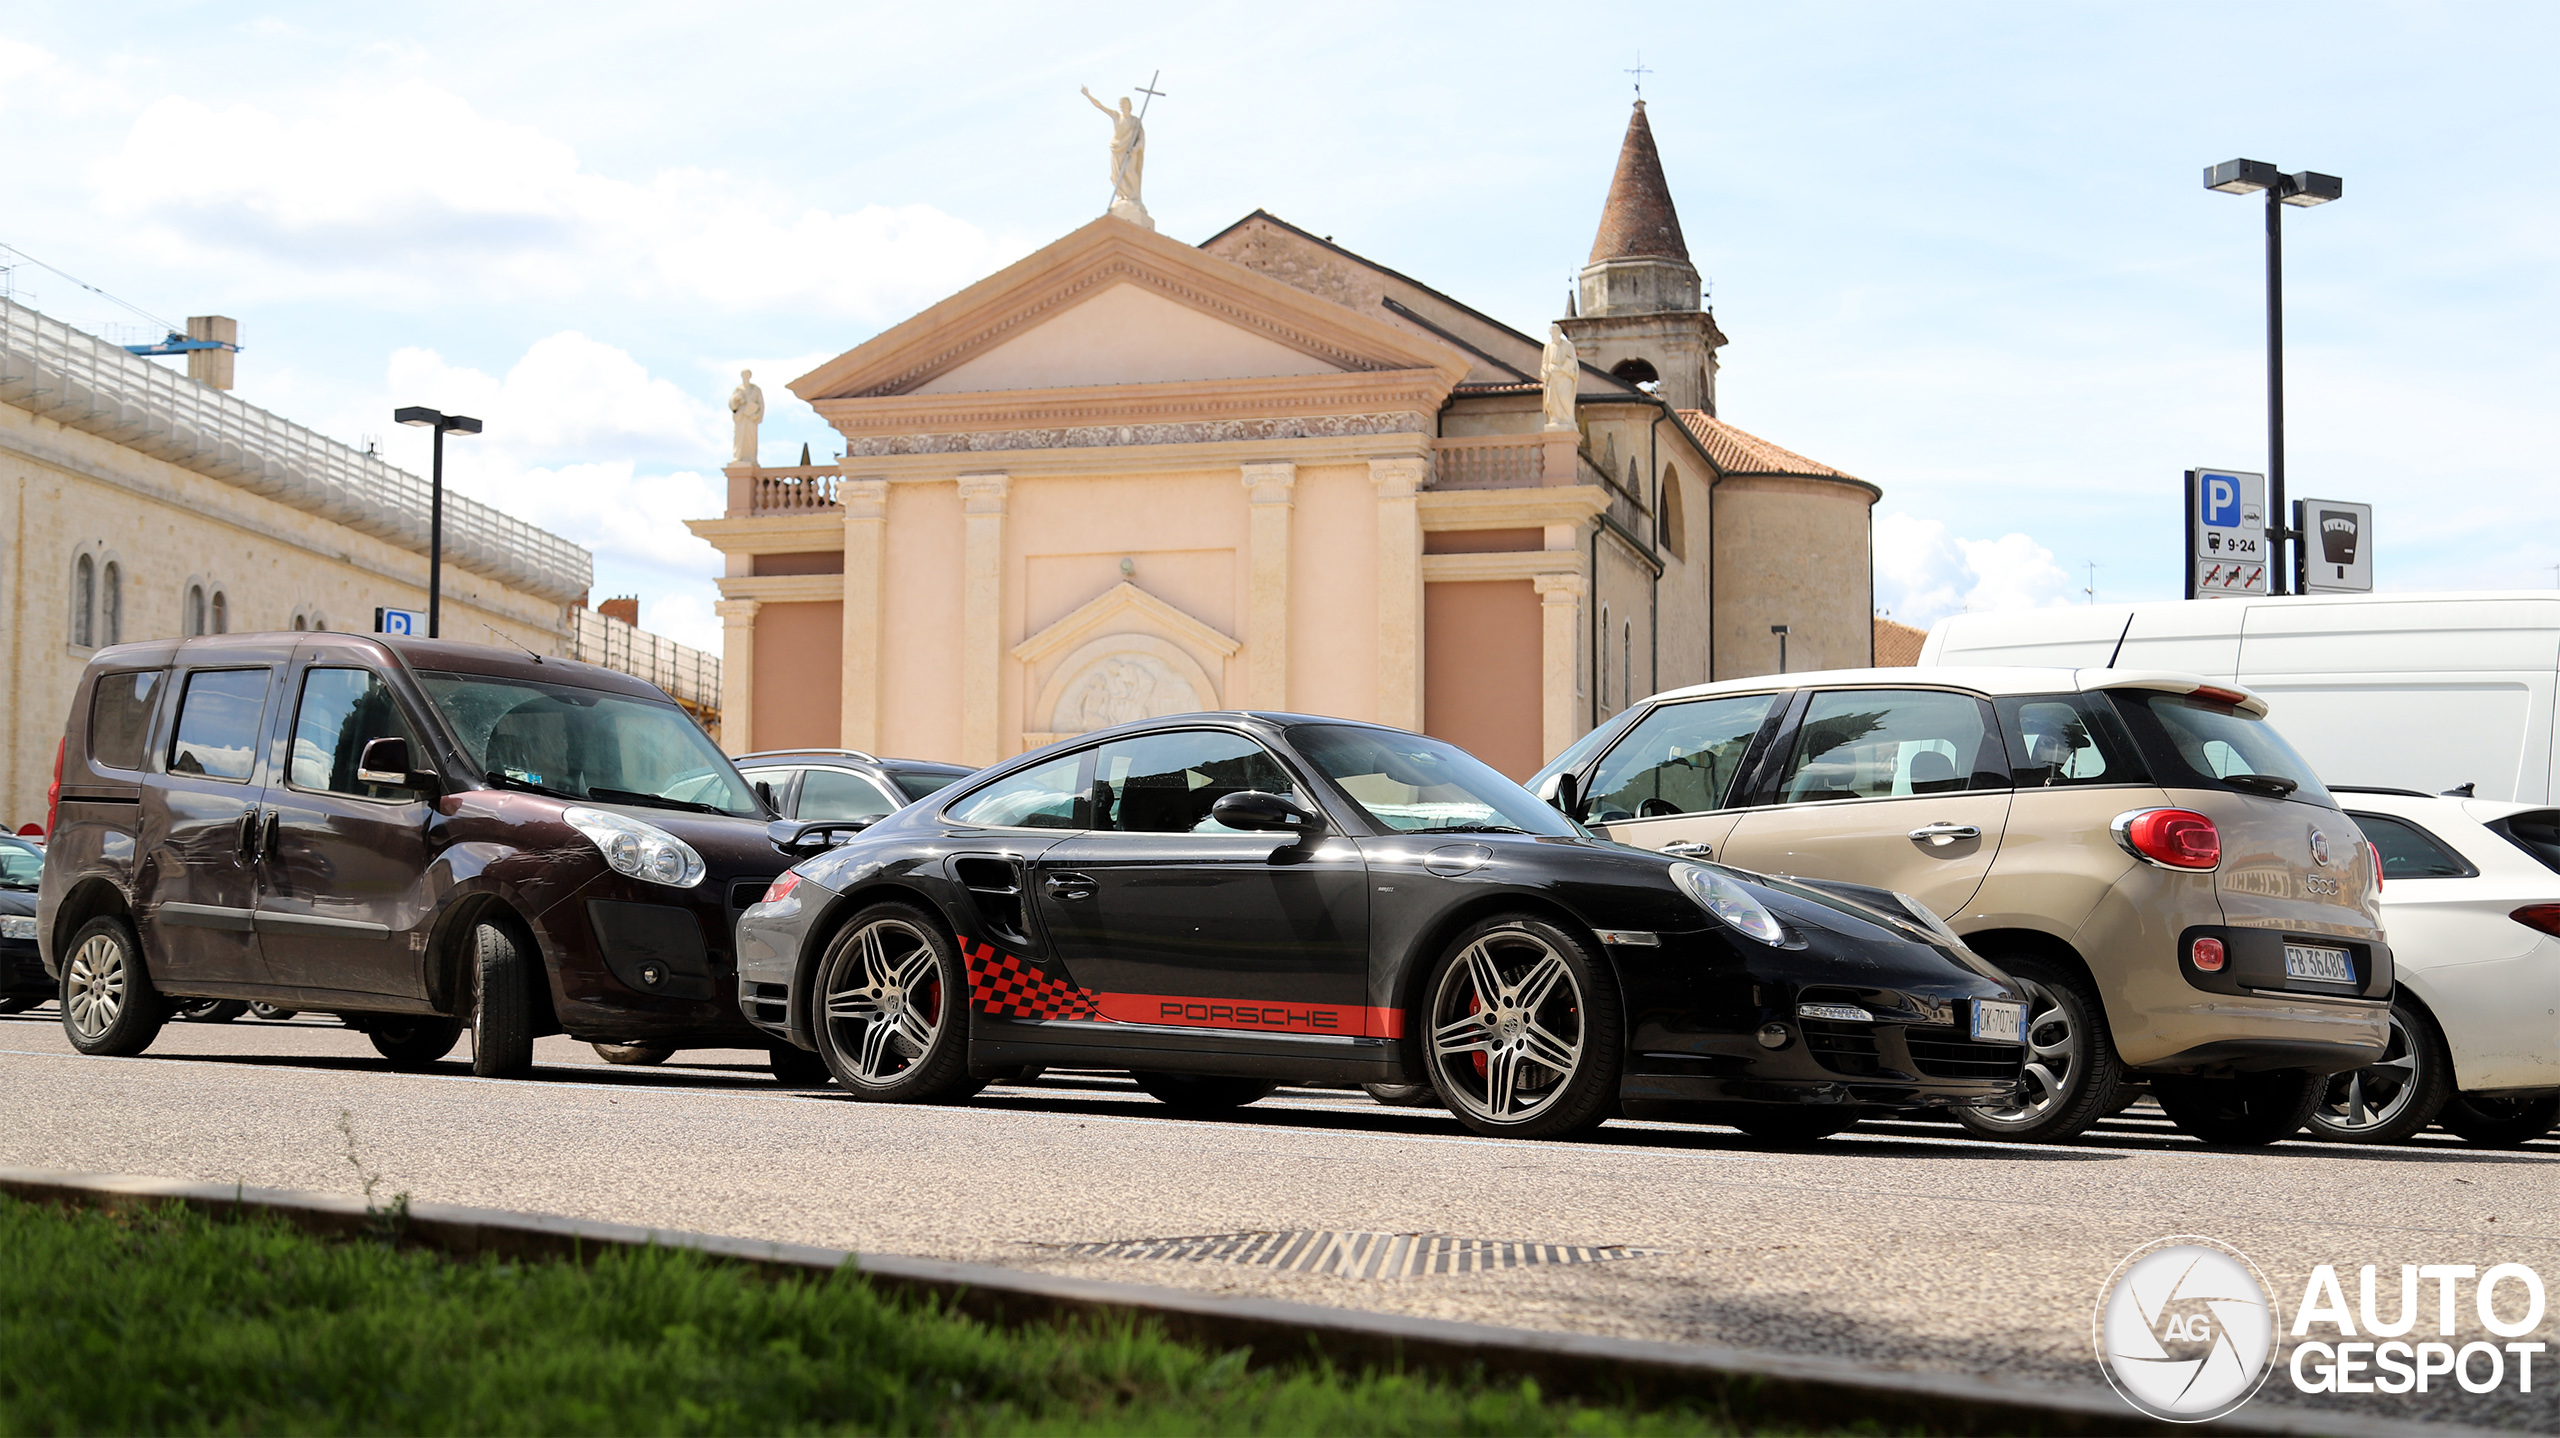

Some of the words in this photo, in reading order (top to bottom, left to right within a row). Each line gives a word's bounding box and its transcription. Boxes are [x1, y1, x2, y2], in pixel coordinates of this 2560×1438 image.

[2209, 479, 2233, 521] P
[2228, 538, 2256, 552] 9-24
[2287, 948, 2306, 975] FB
[2306, 950, 2346, 978] 364BG
[1160, 1003, 1338, 1028] PORSCHE
[1981, 1008, 1992, 1031] DK
[1995, 1009, 2020, 1033] 707HV
